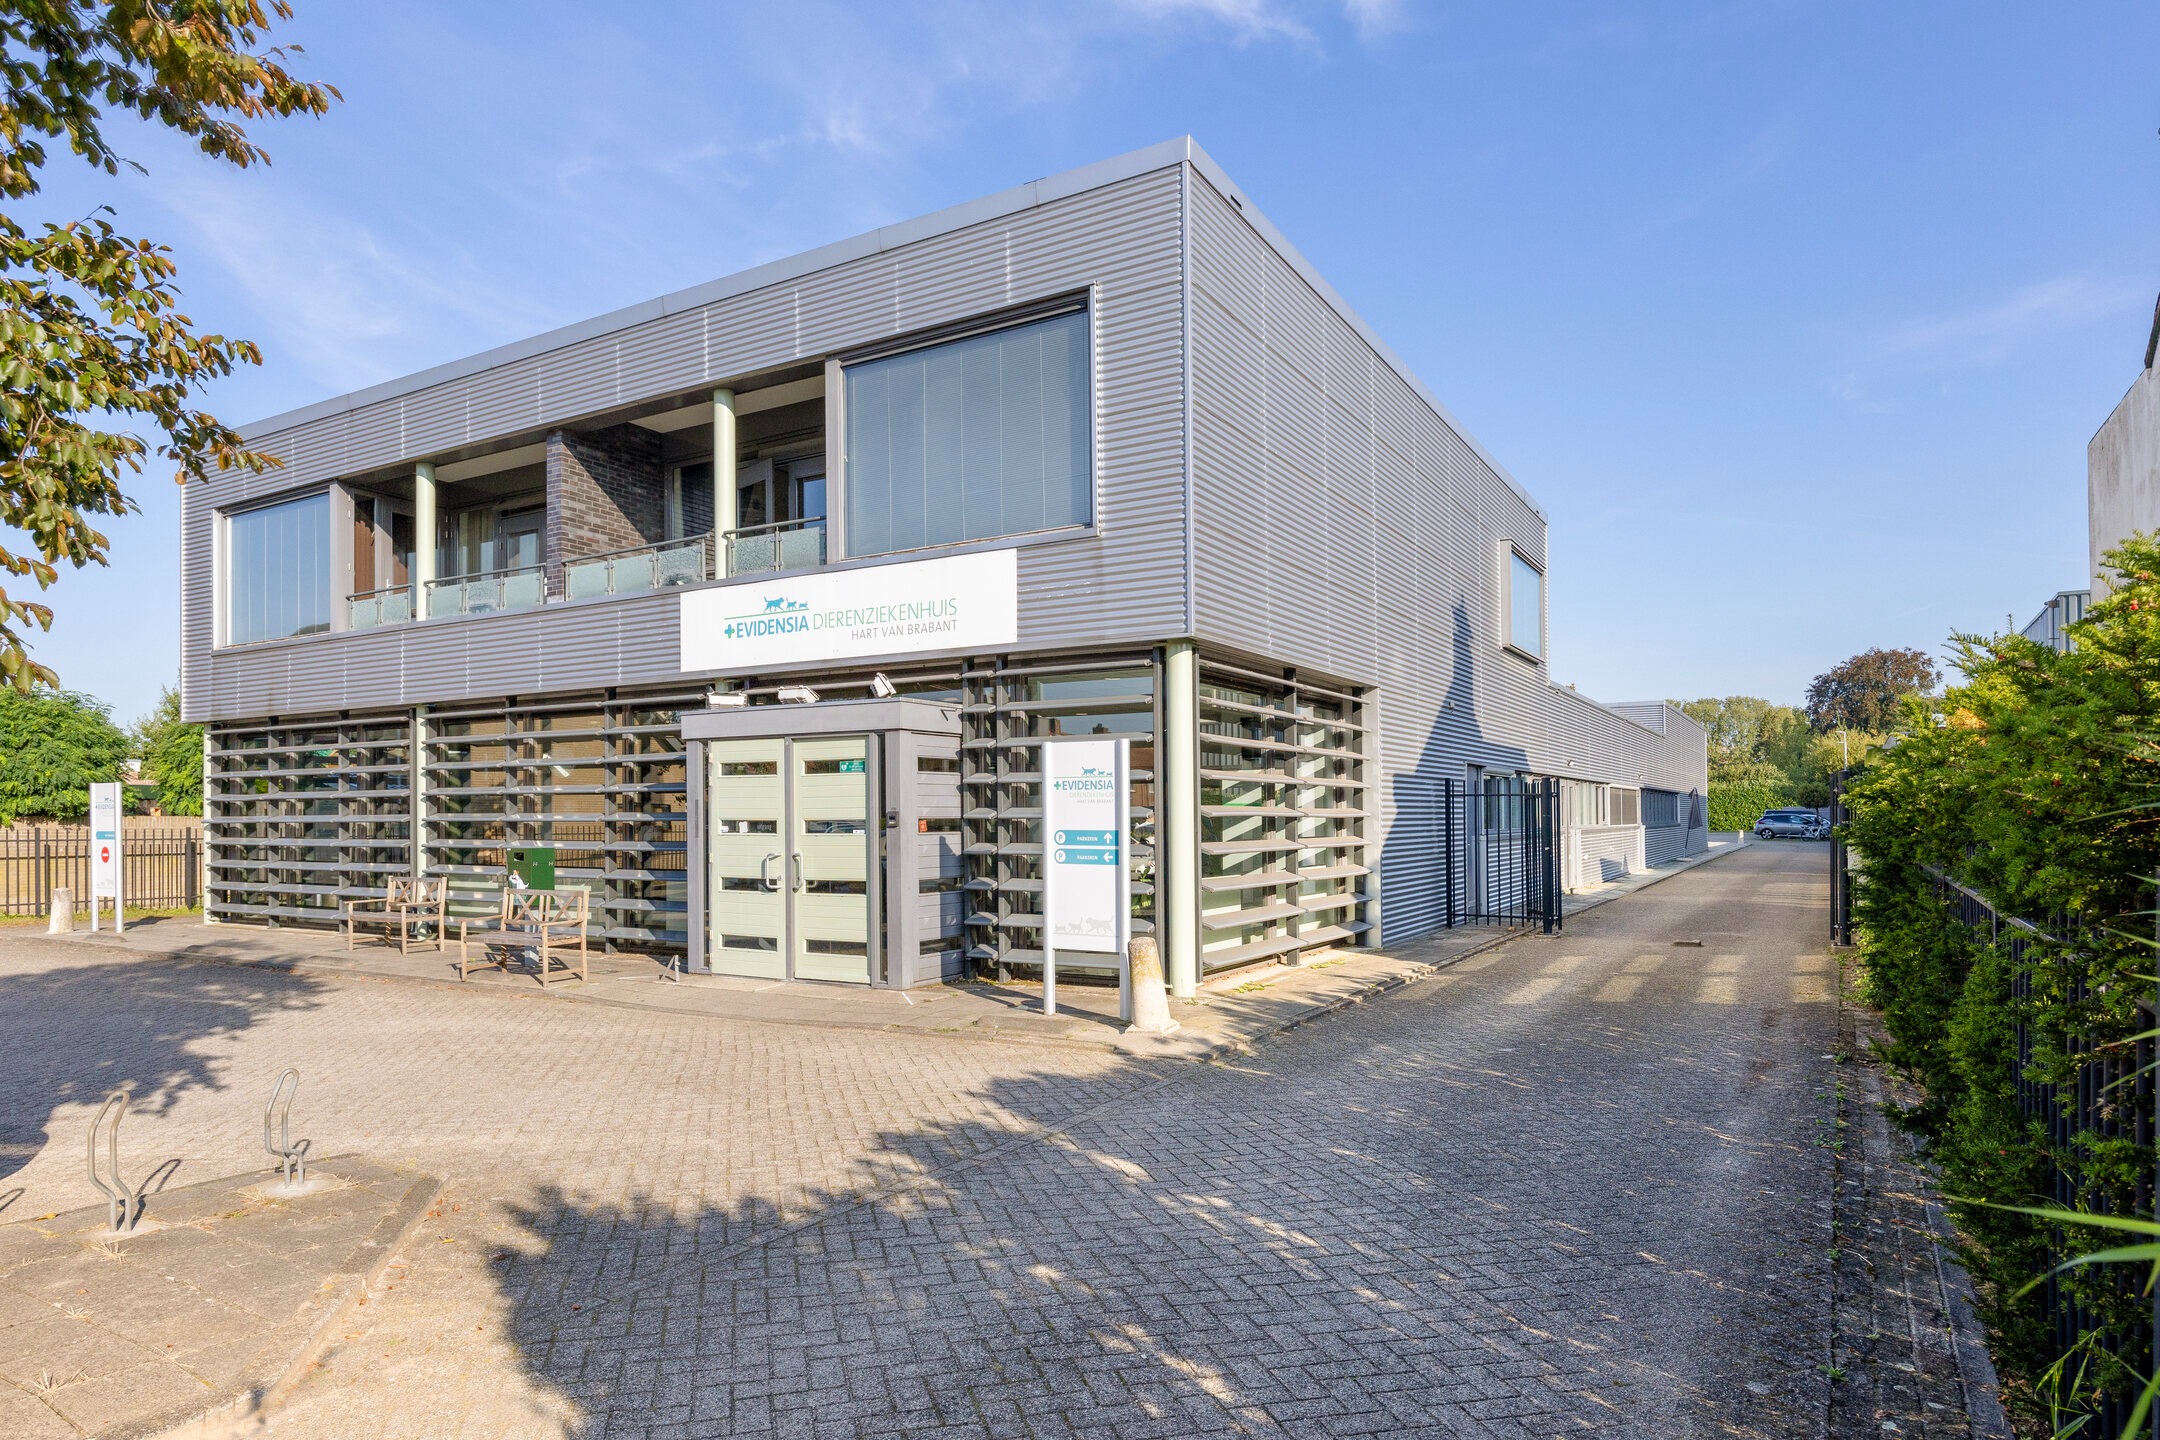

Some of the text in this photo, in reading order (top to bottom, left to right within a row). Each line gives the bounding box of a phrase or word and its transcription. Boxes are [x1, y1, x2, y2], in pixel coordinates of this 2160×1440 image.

[736, 598, 957, 638] EVIDENSIA DIERENZIEKENHUIS
[851, 619, 957, 641] HART VAN BRABANT
[1062, 780, 1114, 790] EVIDENSIA
